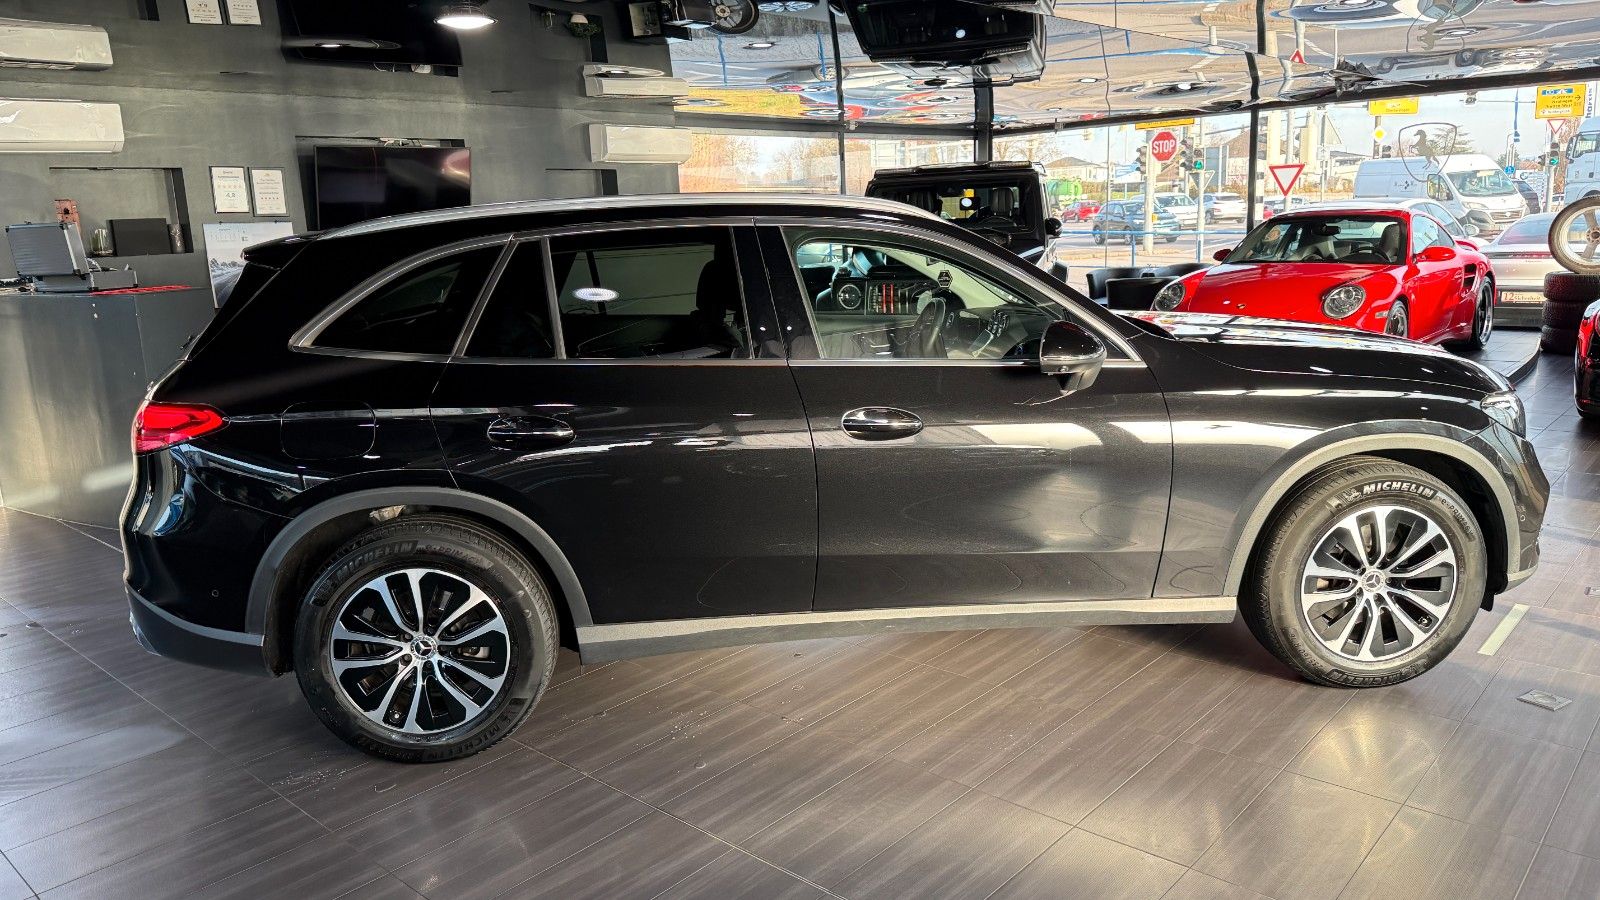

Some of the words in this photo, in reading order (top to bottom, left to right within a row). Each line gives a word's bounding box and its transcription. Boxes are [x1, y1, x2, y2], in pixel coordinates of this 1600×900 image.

[1153, 140, 1176, 154] STOP
[1363, 481, 1434, 498] MICHELIN
[336, 541, 414, 579] MICHELIN
